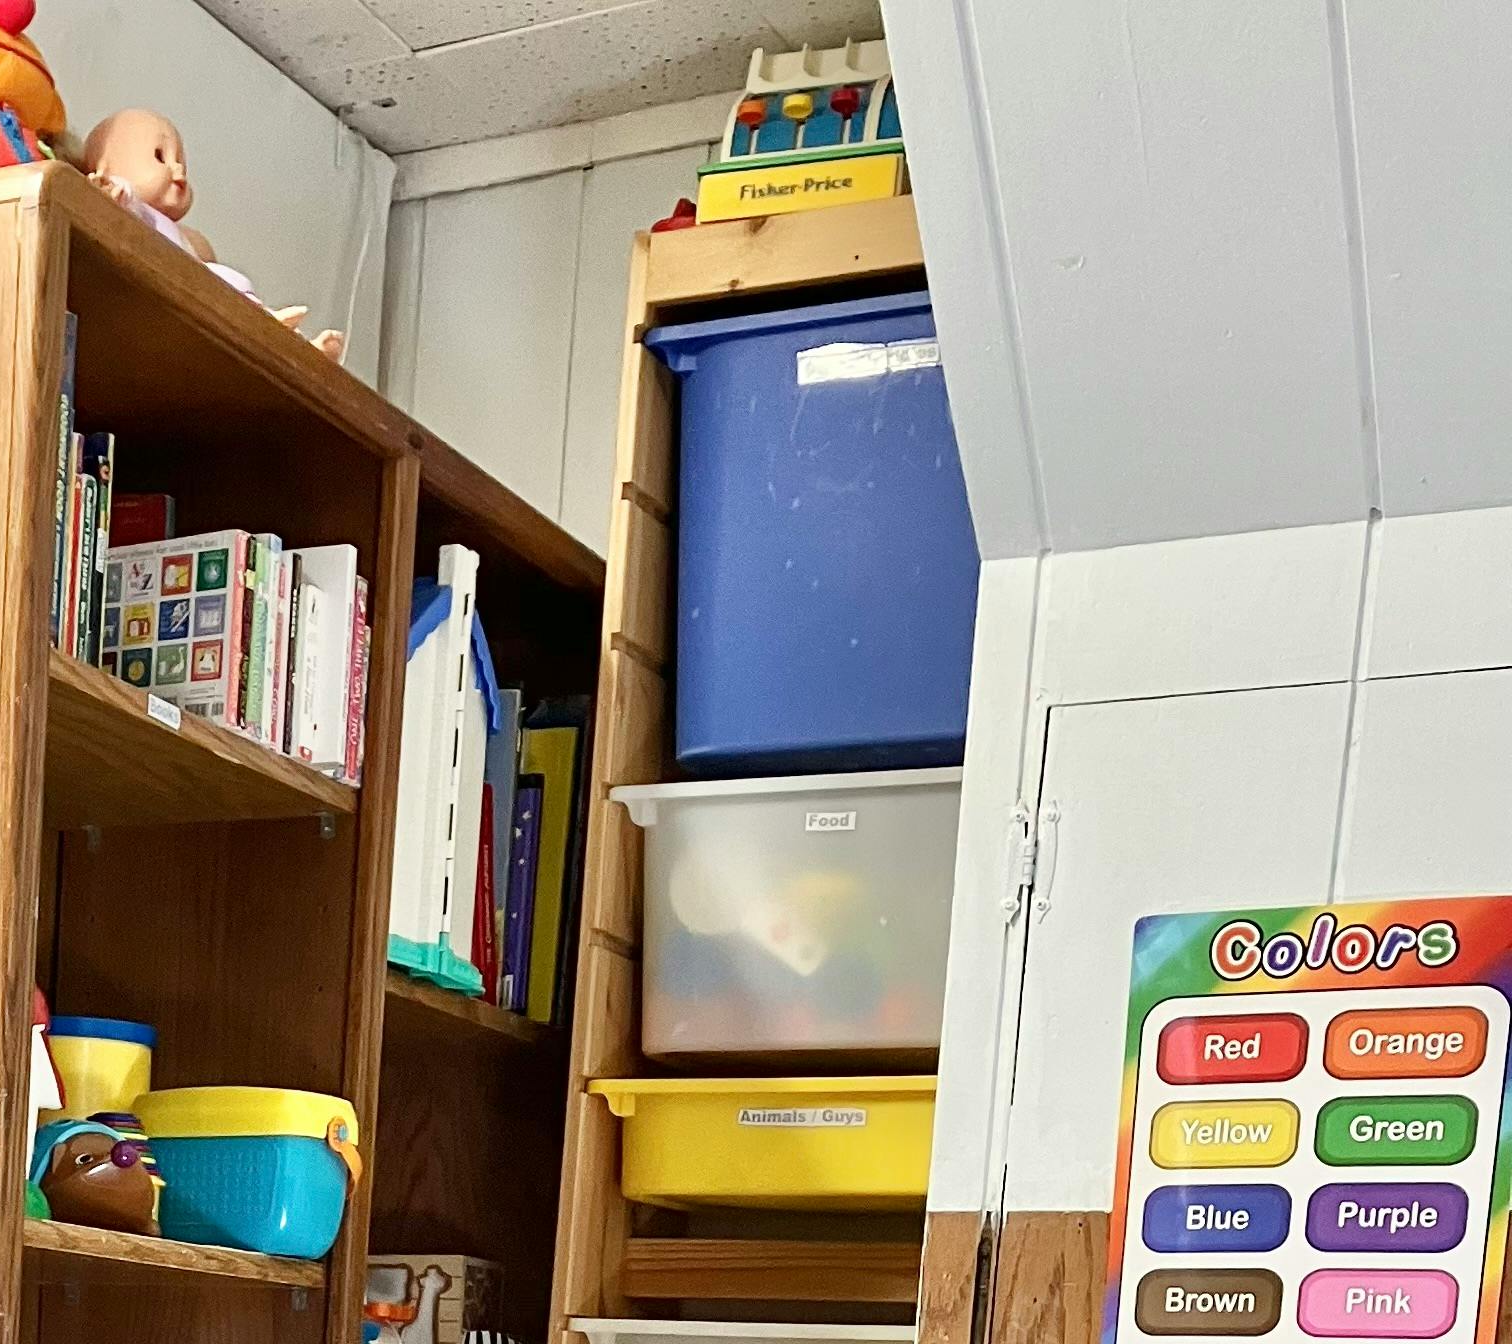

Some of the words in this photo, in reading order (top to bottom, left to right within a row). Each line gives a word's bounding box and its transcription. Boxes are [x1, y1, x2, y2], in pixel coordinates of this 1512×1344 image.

[739, 176, 854, 200] Fisher-Price
[808, 813, 850, 827] Food
[1210, 913, 1459, 981] Colors
[1204, 1033, 1261, 1060] Red
[1349, 1028, 1464, 1060] Orange
[740, 1110, 806, 1123] Animals
[822, 1109, 864, 1125] Guys
[1349, 1115, 1445, 1142] Green
[1181, 1118, 1273, 1145] Yellow
[1185, 1203, 1250, 1230] Blue
[1337, 1200, 1438, 1234] Purple
[1164, 1286, 1256, 1313] Brown
[1345, 1287, 1411, 1314] Pink
